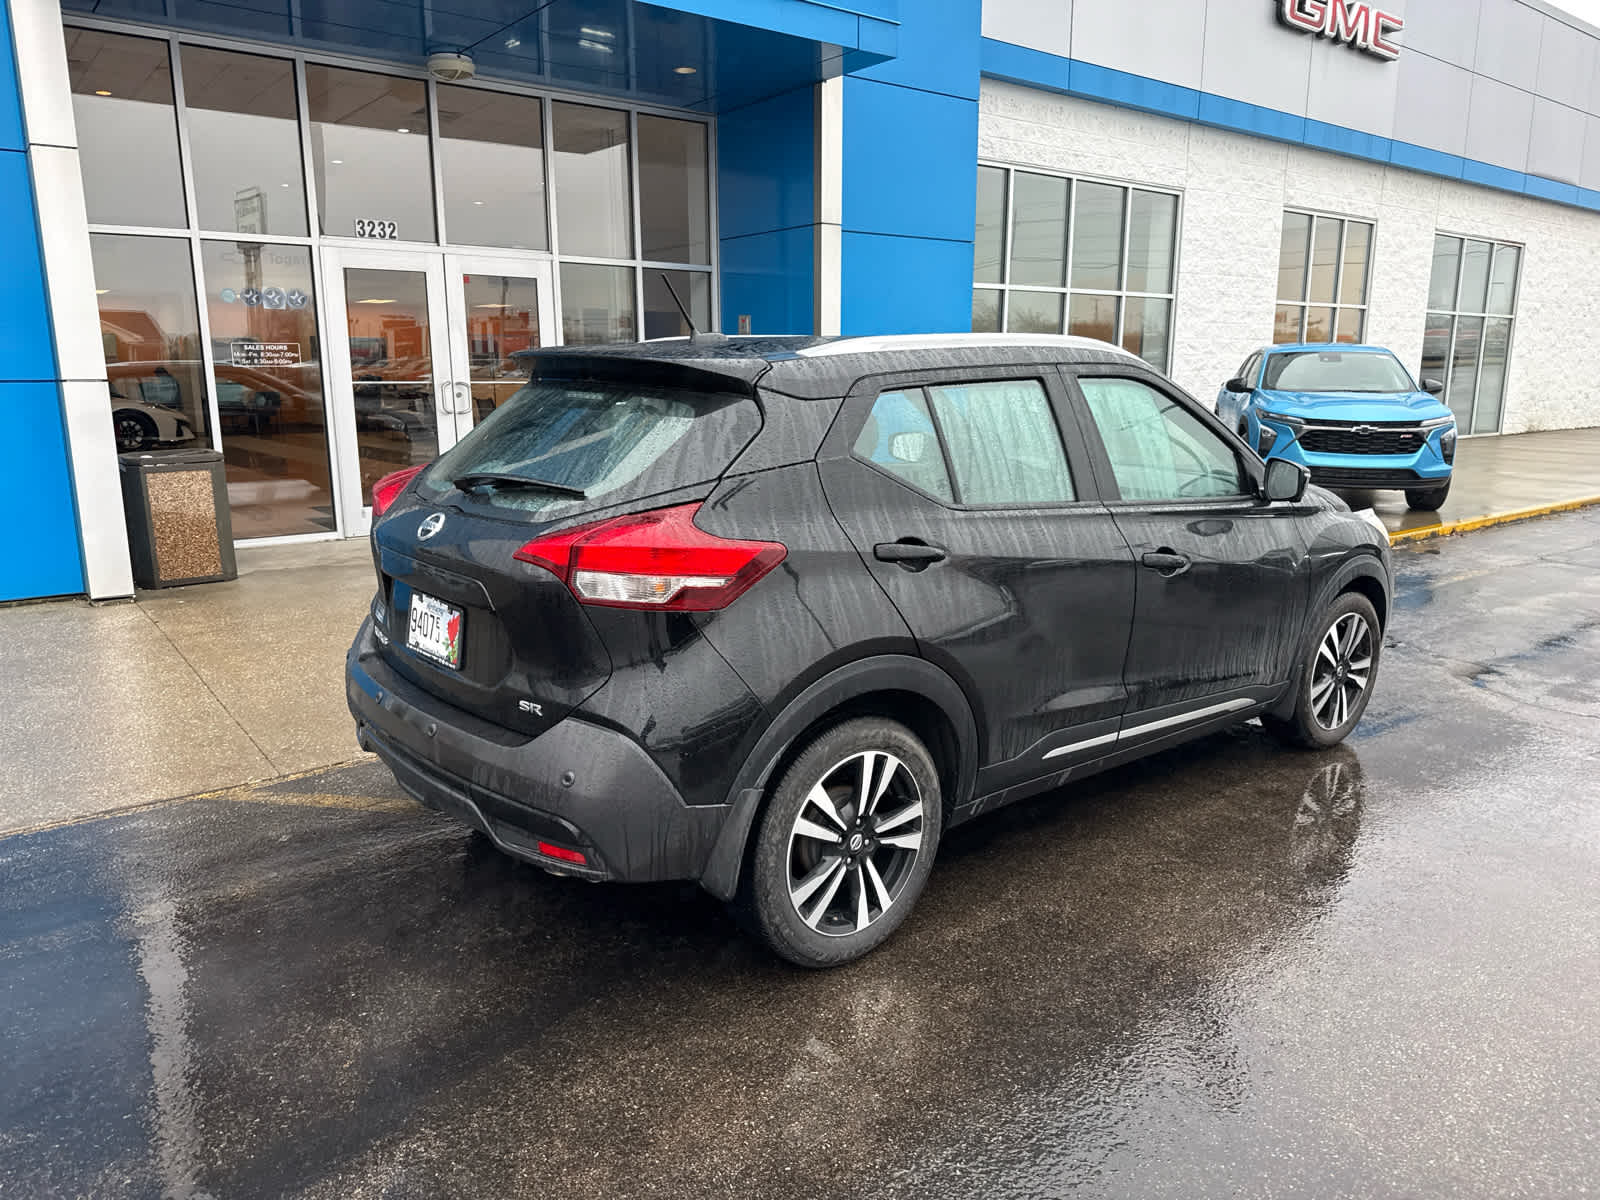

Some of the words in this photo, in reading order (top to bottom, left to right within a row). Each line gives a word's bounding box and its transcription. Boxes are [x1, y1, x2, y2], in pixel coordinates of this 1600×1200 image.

[1284, 0, 1404, 60] GMC
[357, 219, 397, 239] 3232
[519, 700, 543, 716] SR
